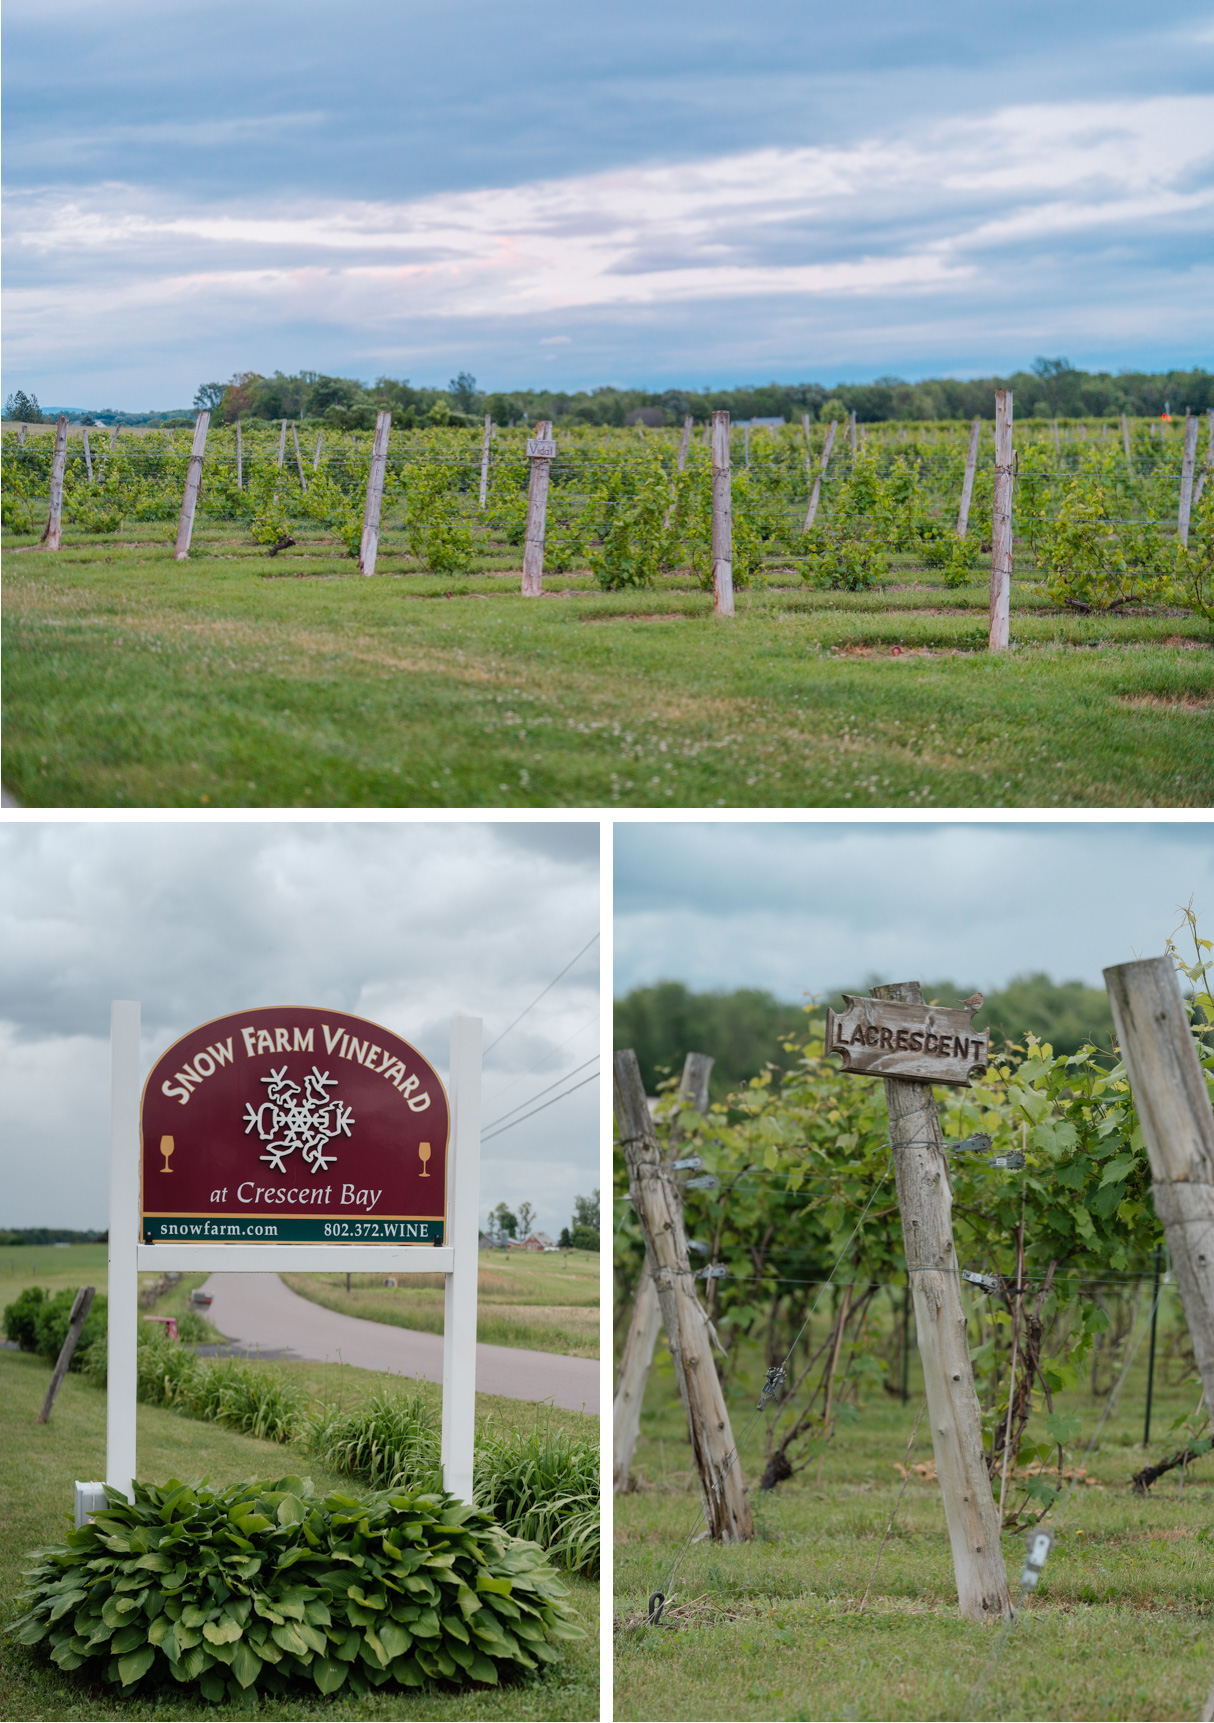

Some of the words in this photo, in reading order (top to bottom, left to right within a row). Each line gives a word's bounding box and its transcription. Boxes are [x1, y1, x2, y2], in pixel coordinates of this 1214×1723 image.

[529, 443, 553, 456] Vidal
[210, 1187, 228, 1203] at
[236, 1182, 332, 1204] Crescent
[340, 1184, 382, 1211] Bay
[160, 1221, 278, 1236] snowfarm.com
[324, 1223, 429, 1237] 802.372.WINE
